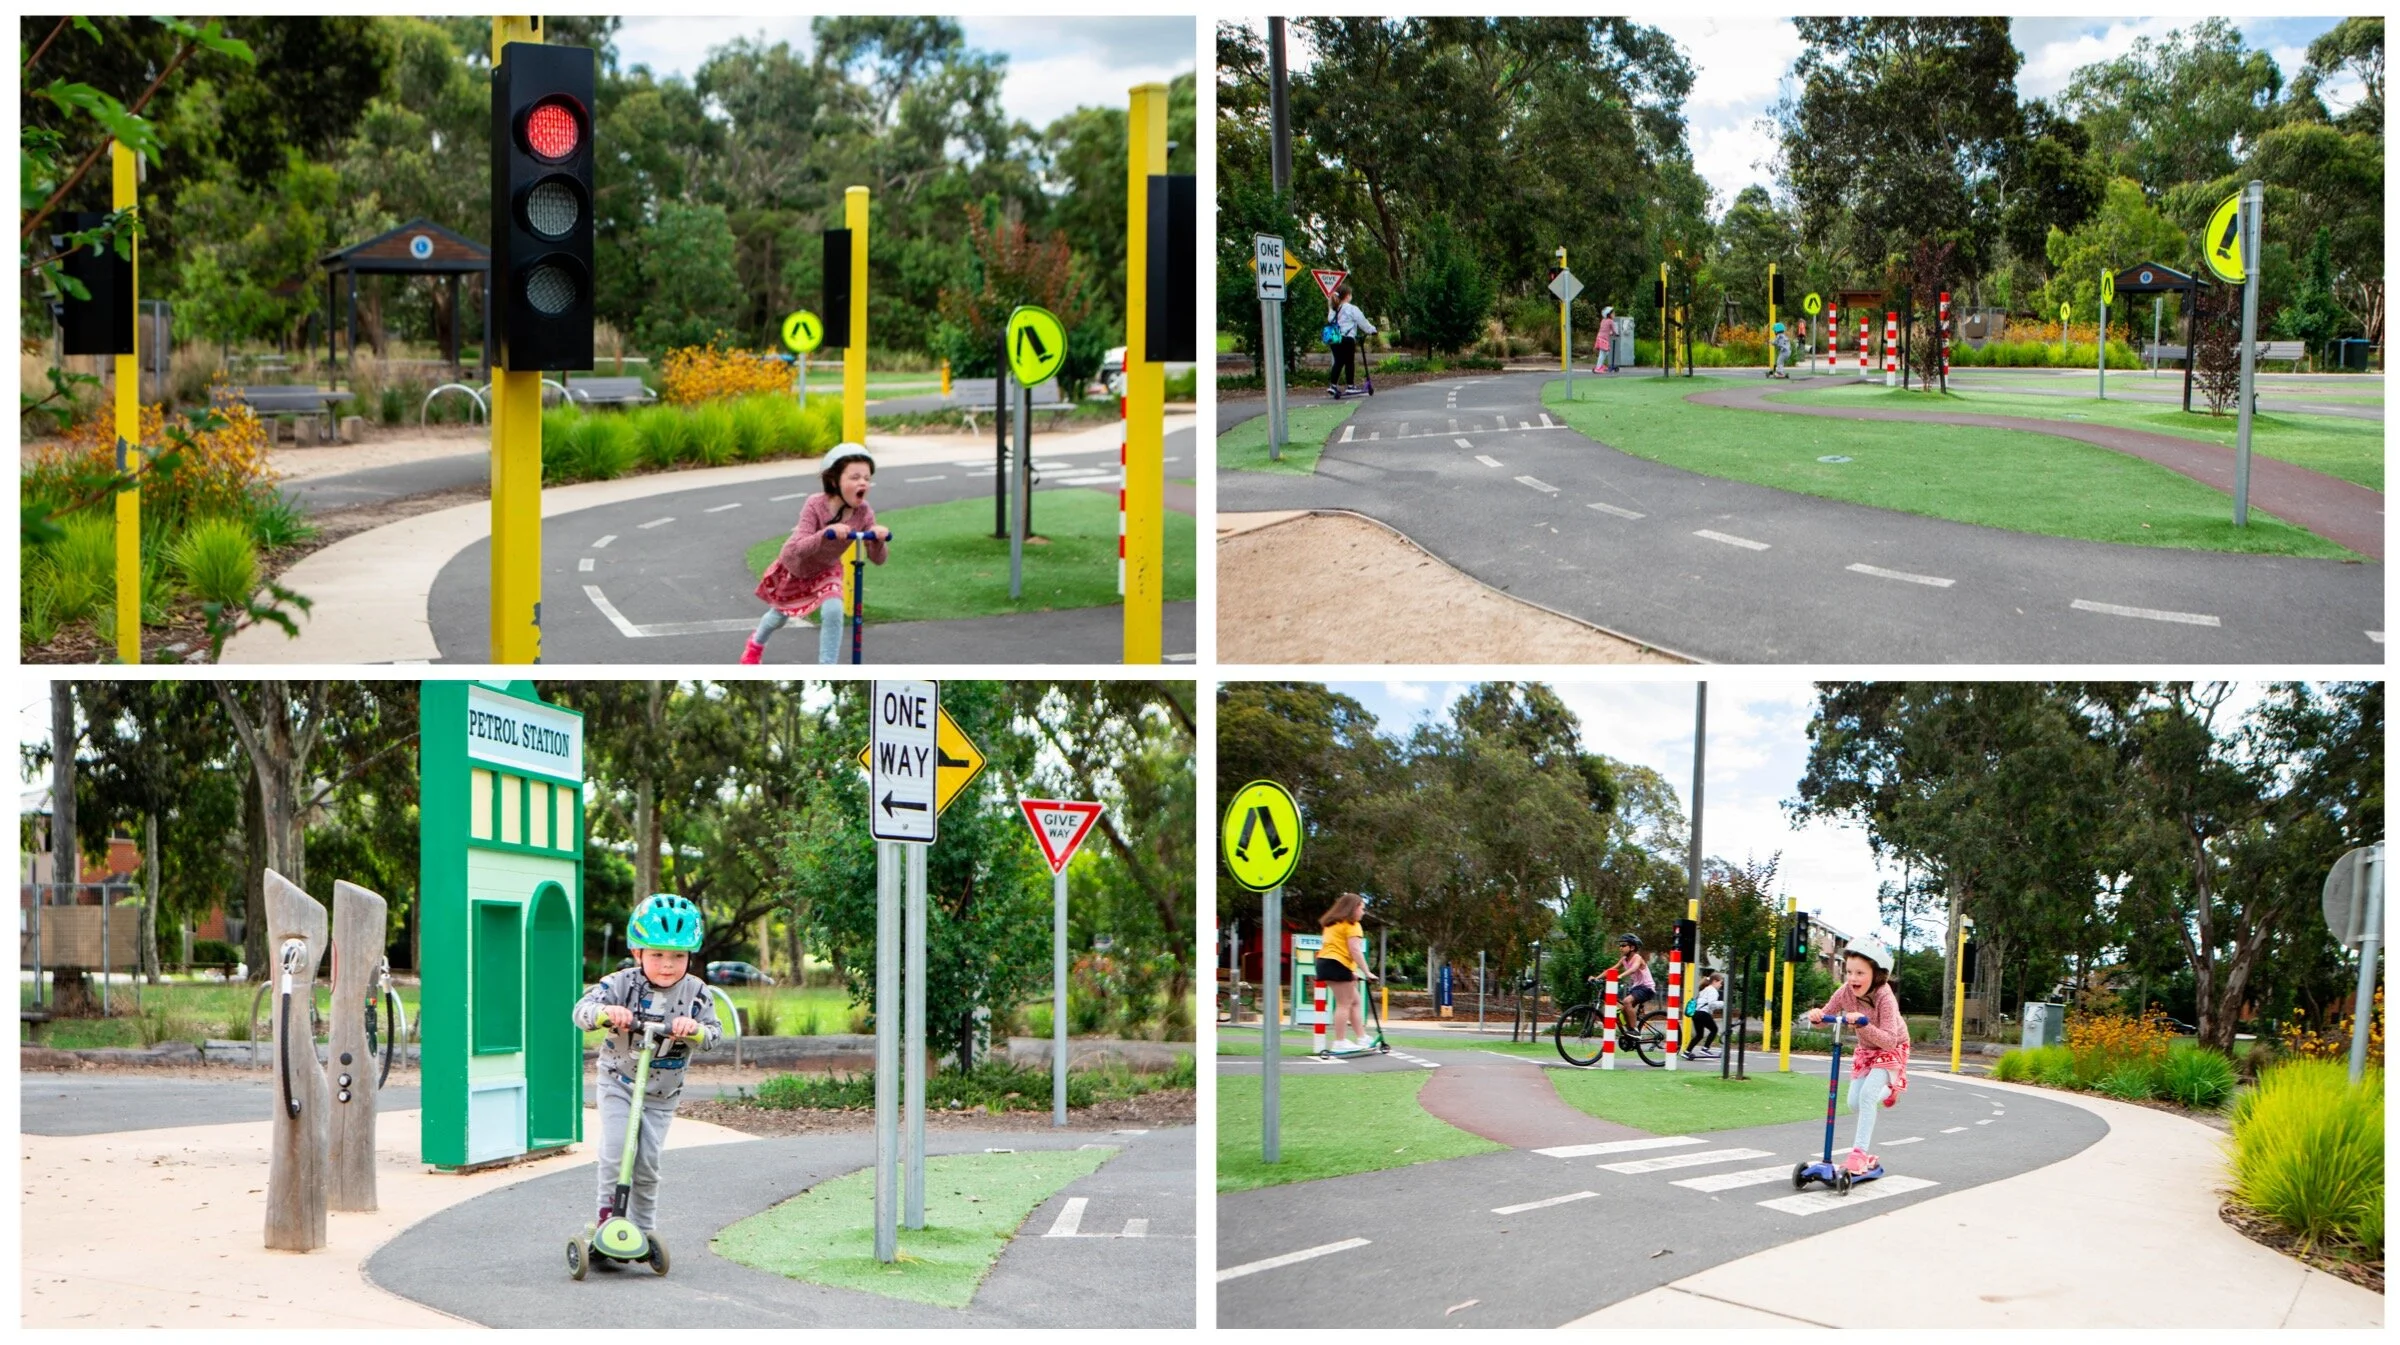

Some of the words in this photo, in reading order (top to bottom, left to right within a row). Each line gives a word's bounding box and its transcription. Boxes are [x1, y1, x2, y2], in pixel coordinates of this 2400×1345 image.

[1260, 243, 1280, 258] ONE
[1259, 261, 1282, 277] WAY
[884, 692, 927, 729] ONE
[469, 709, 519, 746] PETROL
[522, 723, 569, 758] STATION
[880, 742, 929, 778] WAY
[1044, 814, 1078, 828] GIVE
[1049, 828, 1071, 839] WAY
